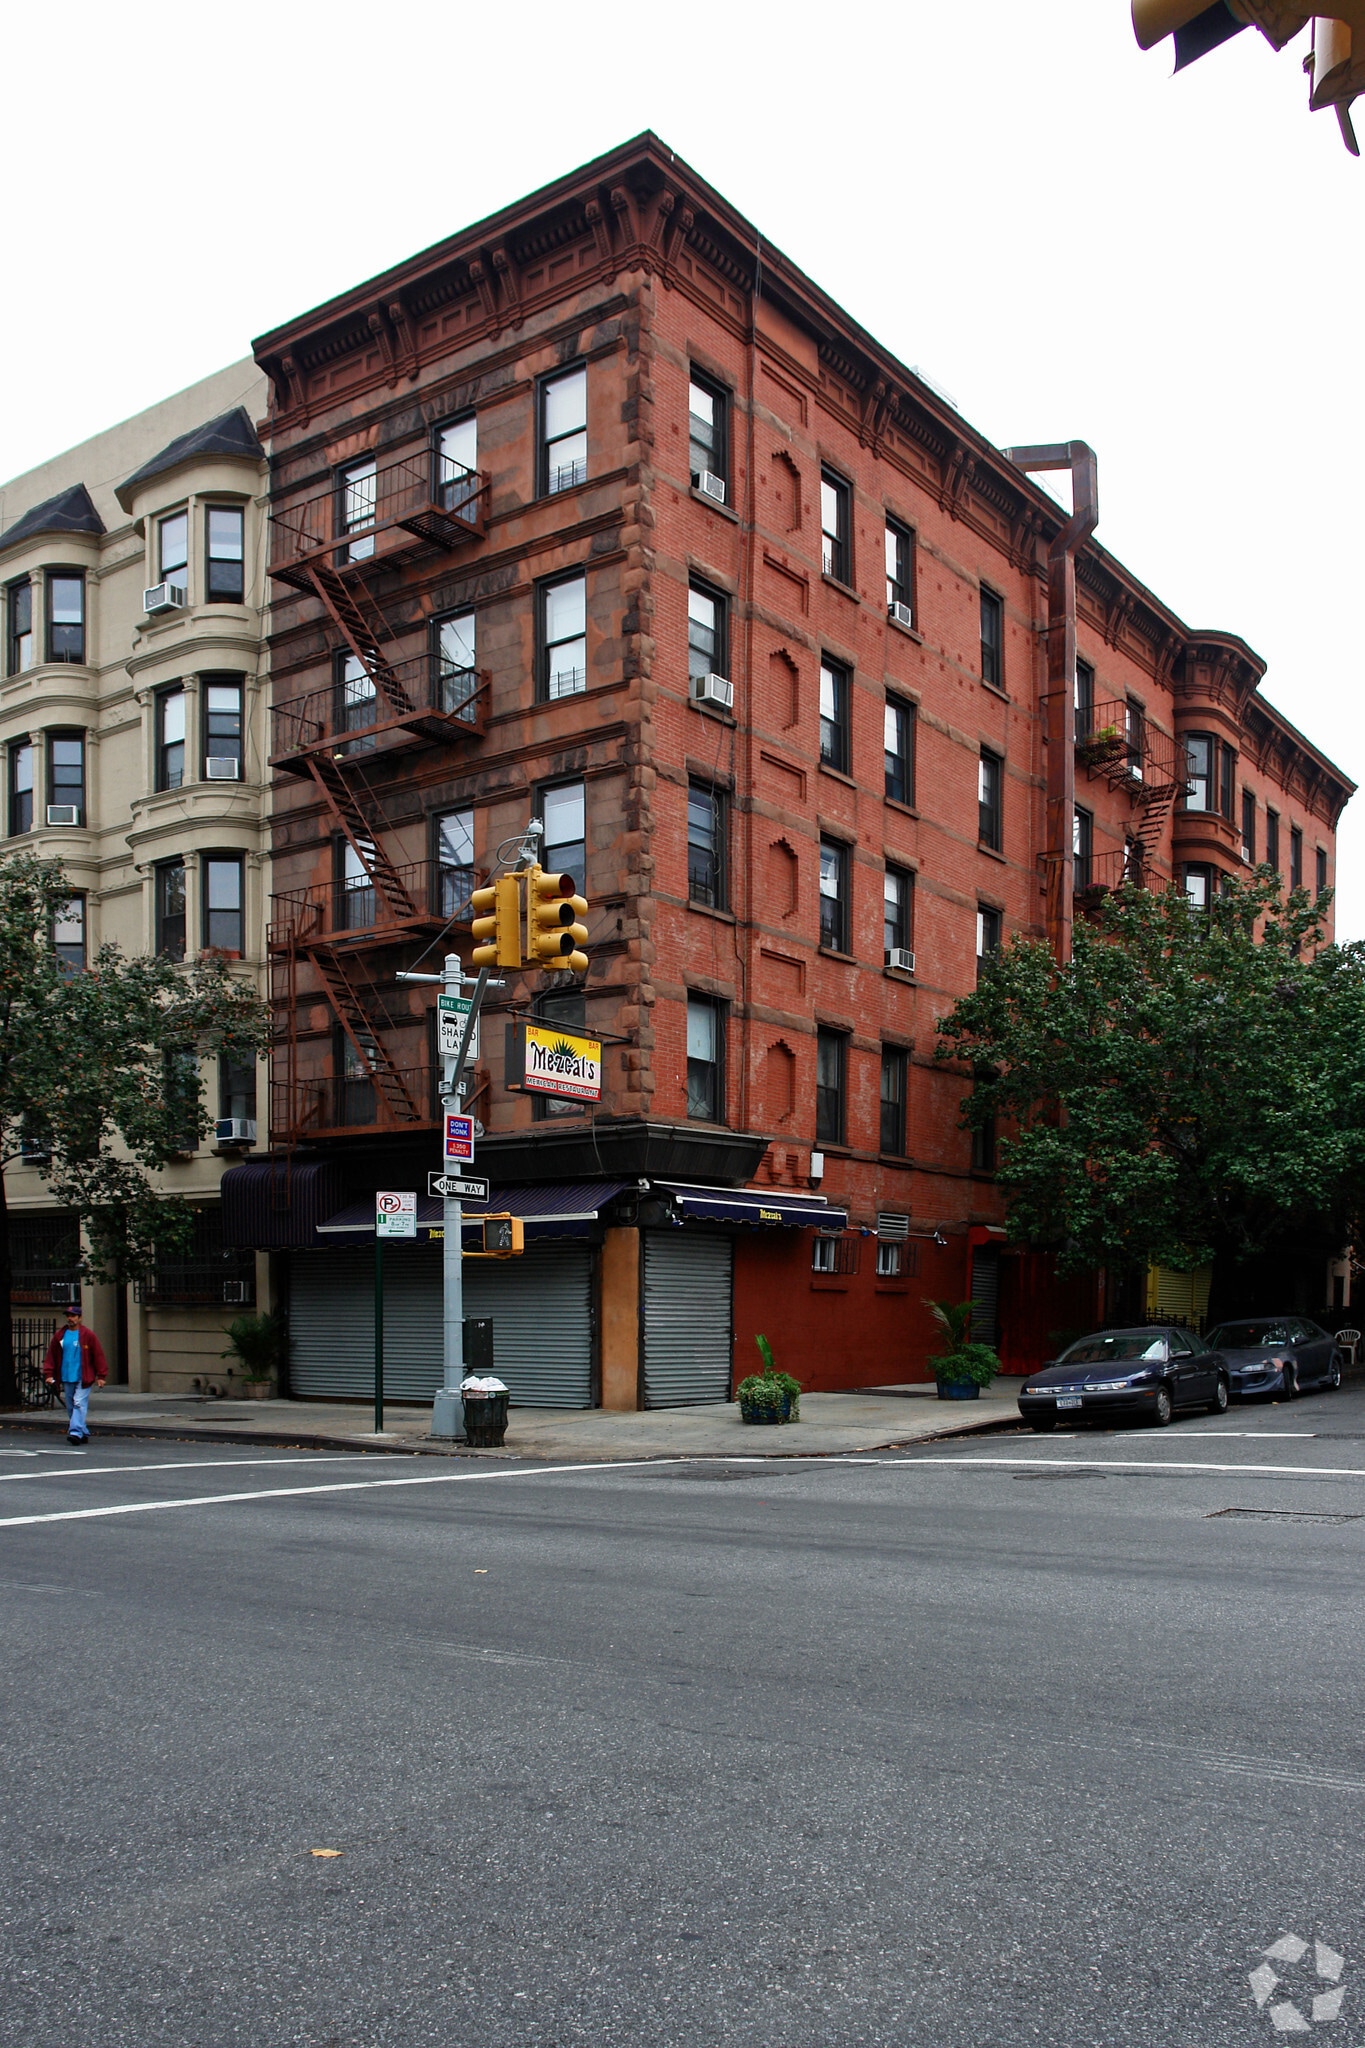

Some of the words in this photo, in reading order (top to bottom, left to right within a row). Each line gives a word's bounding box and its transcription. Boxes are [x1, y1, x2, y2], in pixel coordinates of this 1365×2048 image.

[440, 999, 455, 1009] BIKE
[456, 1002, 472, 1012] ROU
[441, 1026, 477, 1041] SHARD
[527, 1027, 539, 1037] BAR
[588, 1041, 599, 1050] BAR
[530, 1041, 595, 1080] Mezcal's
[526, 1077, 557, 1090] MEXICAN
[557, 1082, 599, 1098] RESTAURANT
[450, 1120, 468, 1129] DON'T
[450, 1128, 468, 1136] HONK
[439, 1180, 457, 1191] ONE
[464, 1183, 482, 1194] WAY
